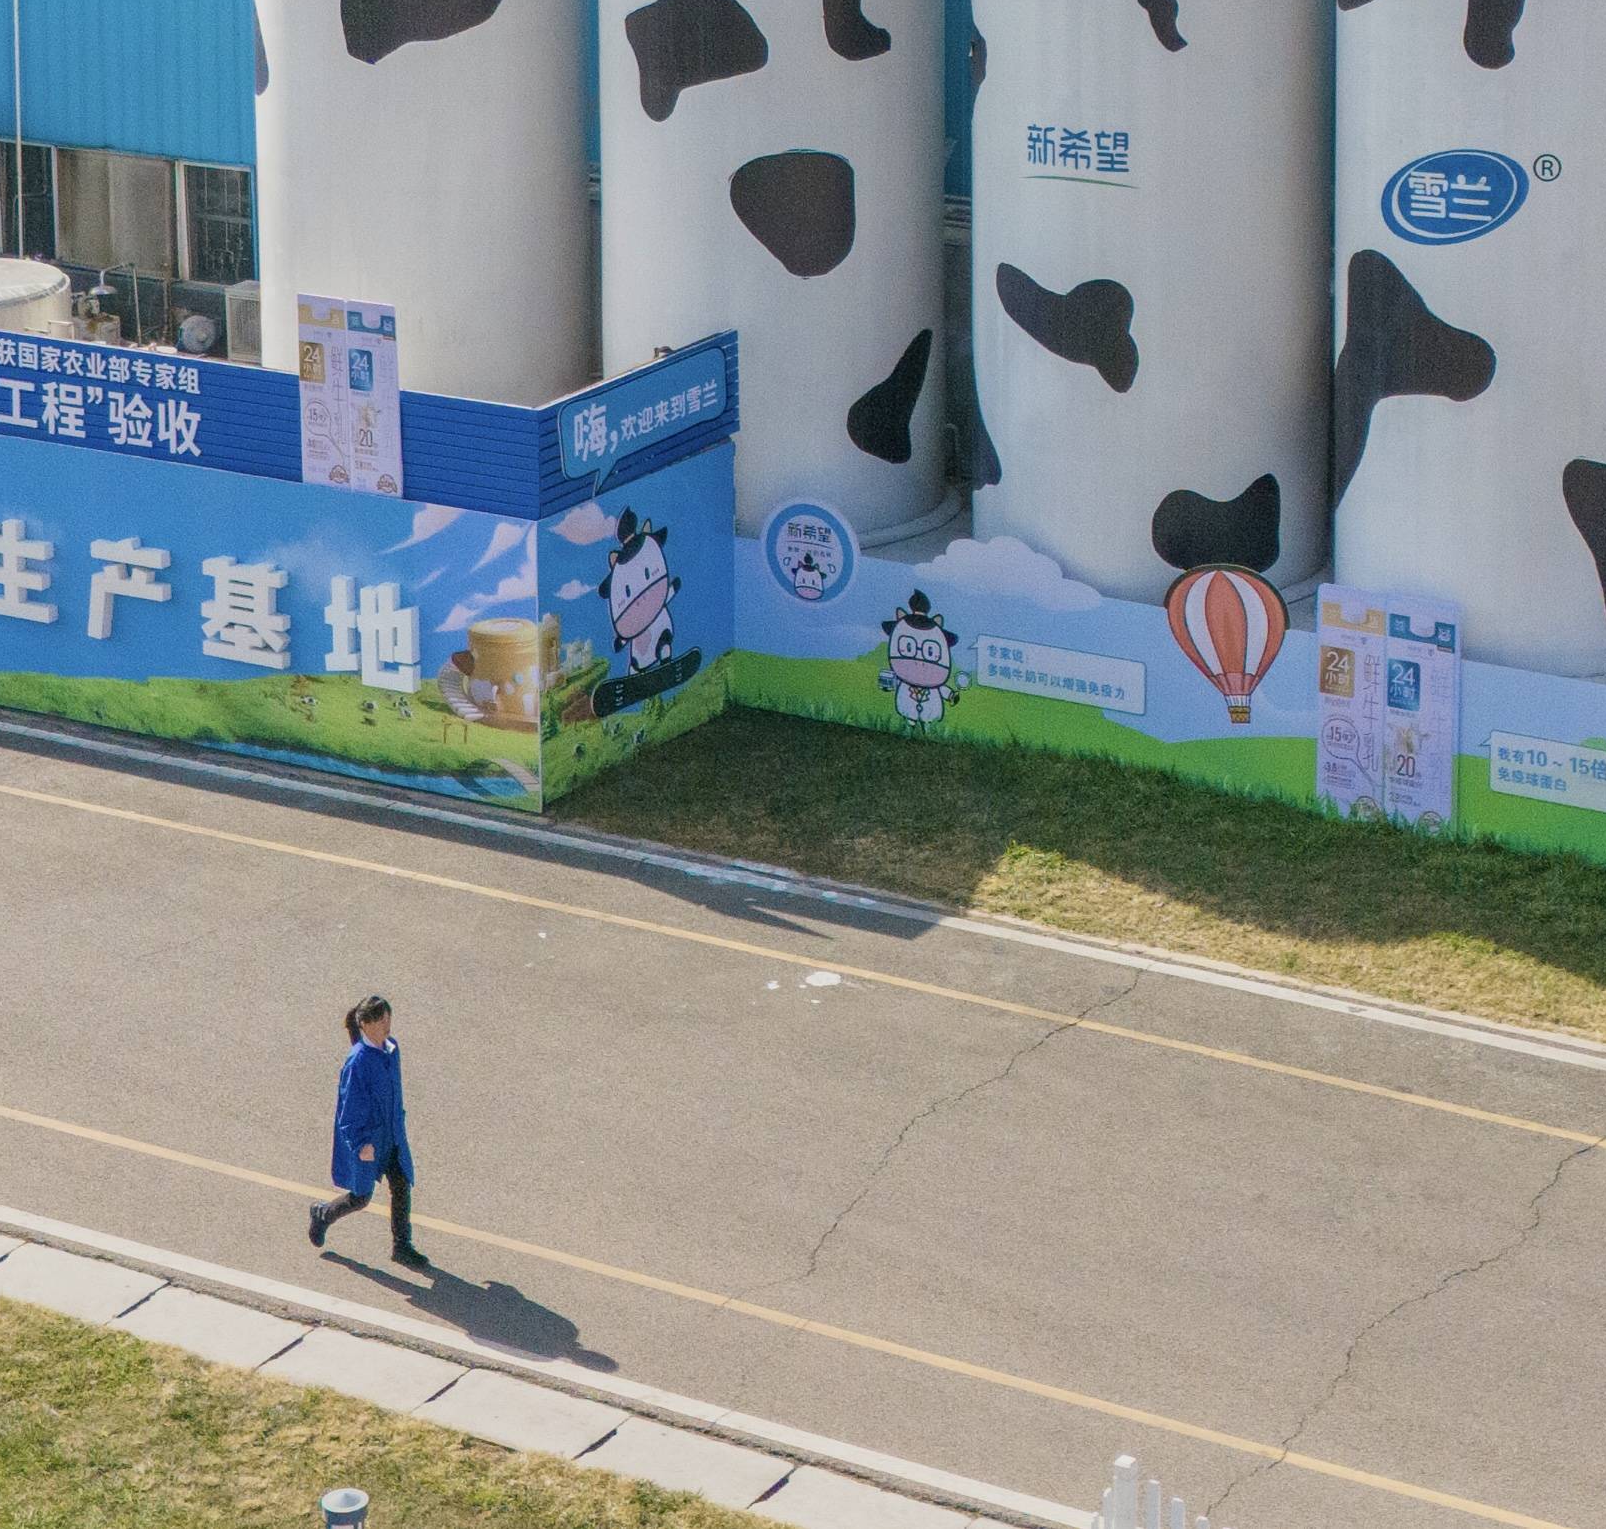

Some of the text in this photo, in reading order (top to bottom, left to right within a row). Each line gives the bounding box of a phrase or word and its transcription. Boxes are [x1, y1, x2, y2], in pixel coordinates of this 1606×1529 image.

[1027, 123, 1129, 172] 新希望
[1408, 170, 1492, 222] 雪兰
[303, 345, 320, 363] 24
[351, 351, 369, 370] 24
[787, 522, 832, 543] 新希望
[1326, 651, 1350, 673] 24
[1391, 663, 1415, 686] 24
